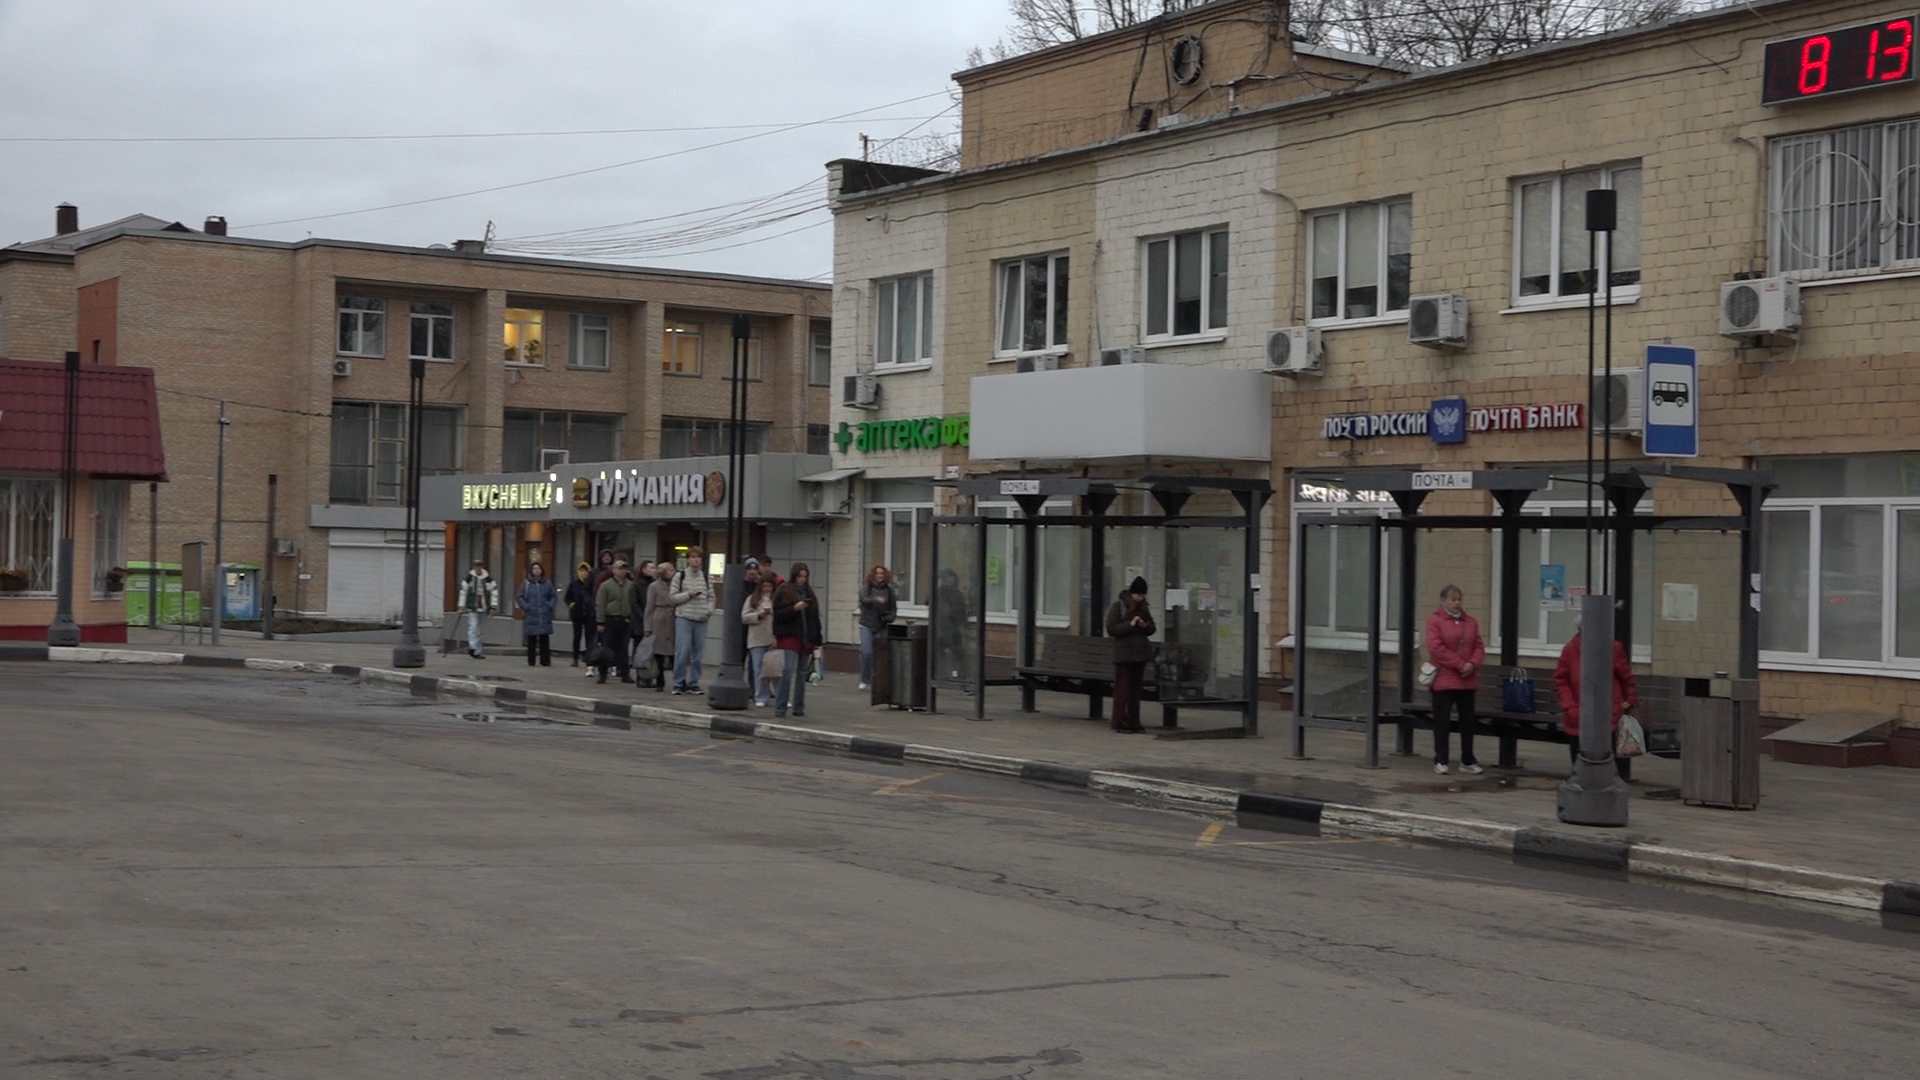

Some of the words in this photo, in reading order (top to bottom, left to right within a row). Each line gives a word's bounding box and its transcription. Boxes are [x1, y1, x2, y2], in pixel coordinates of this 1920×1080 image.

[1799, 36, 1831, 95] 8
[1866, 20, 1912, 80] 13
[1370, 413, 1428, 436] РОССИИ
[1469, 408, 1522, 431] ПОЧТА
[1525, 404, 1580, 428] БАНК
[591, 474, 705, 505] ГУРМАНИЯ
[1415, 474, 1456, 487] ПОЧТА
